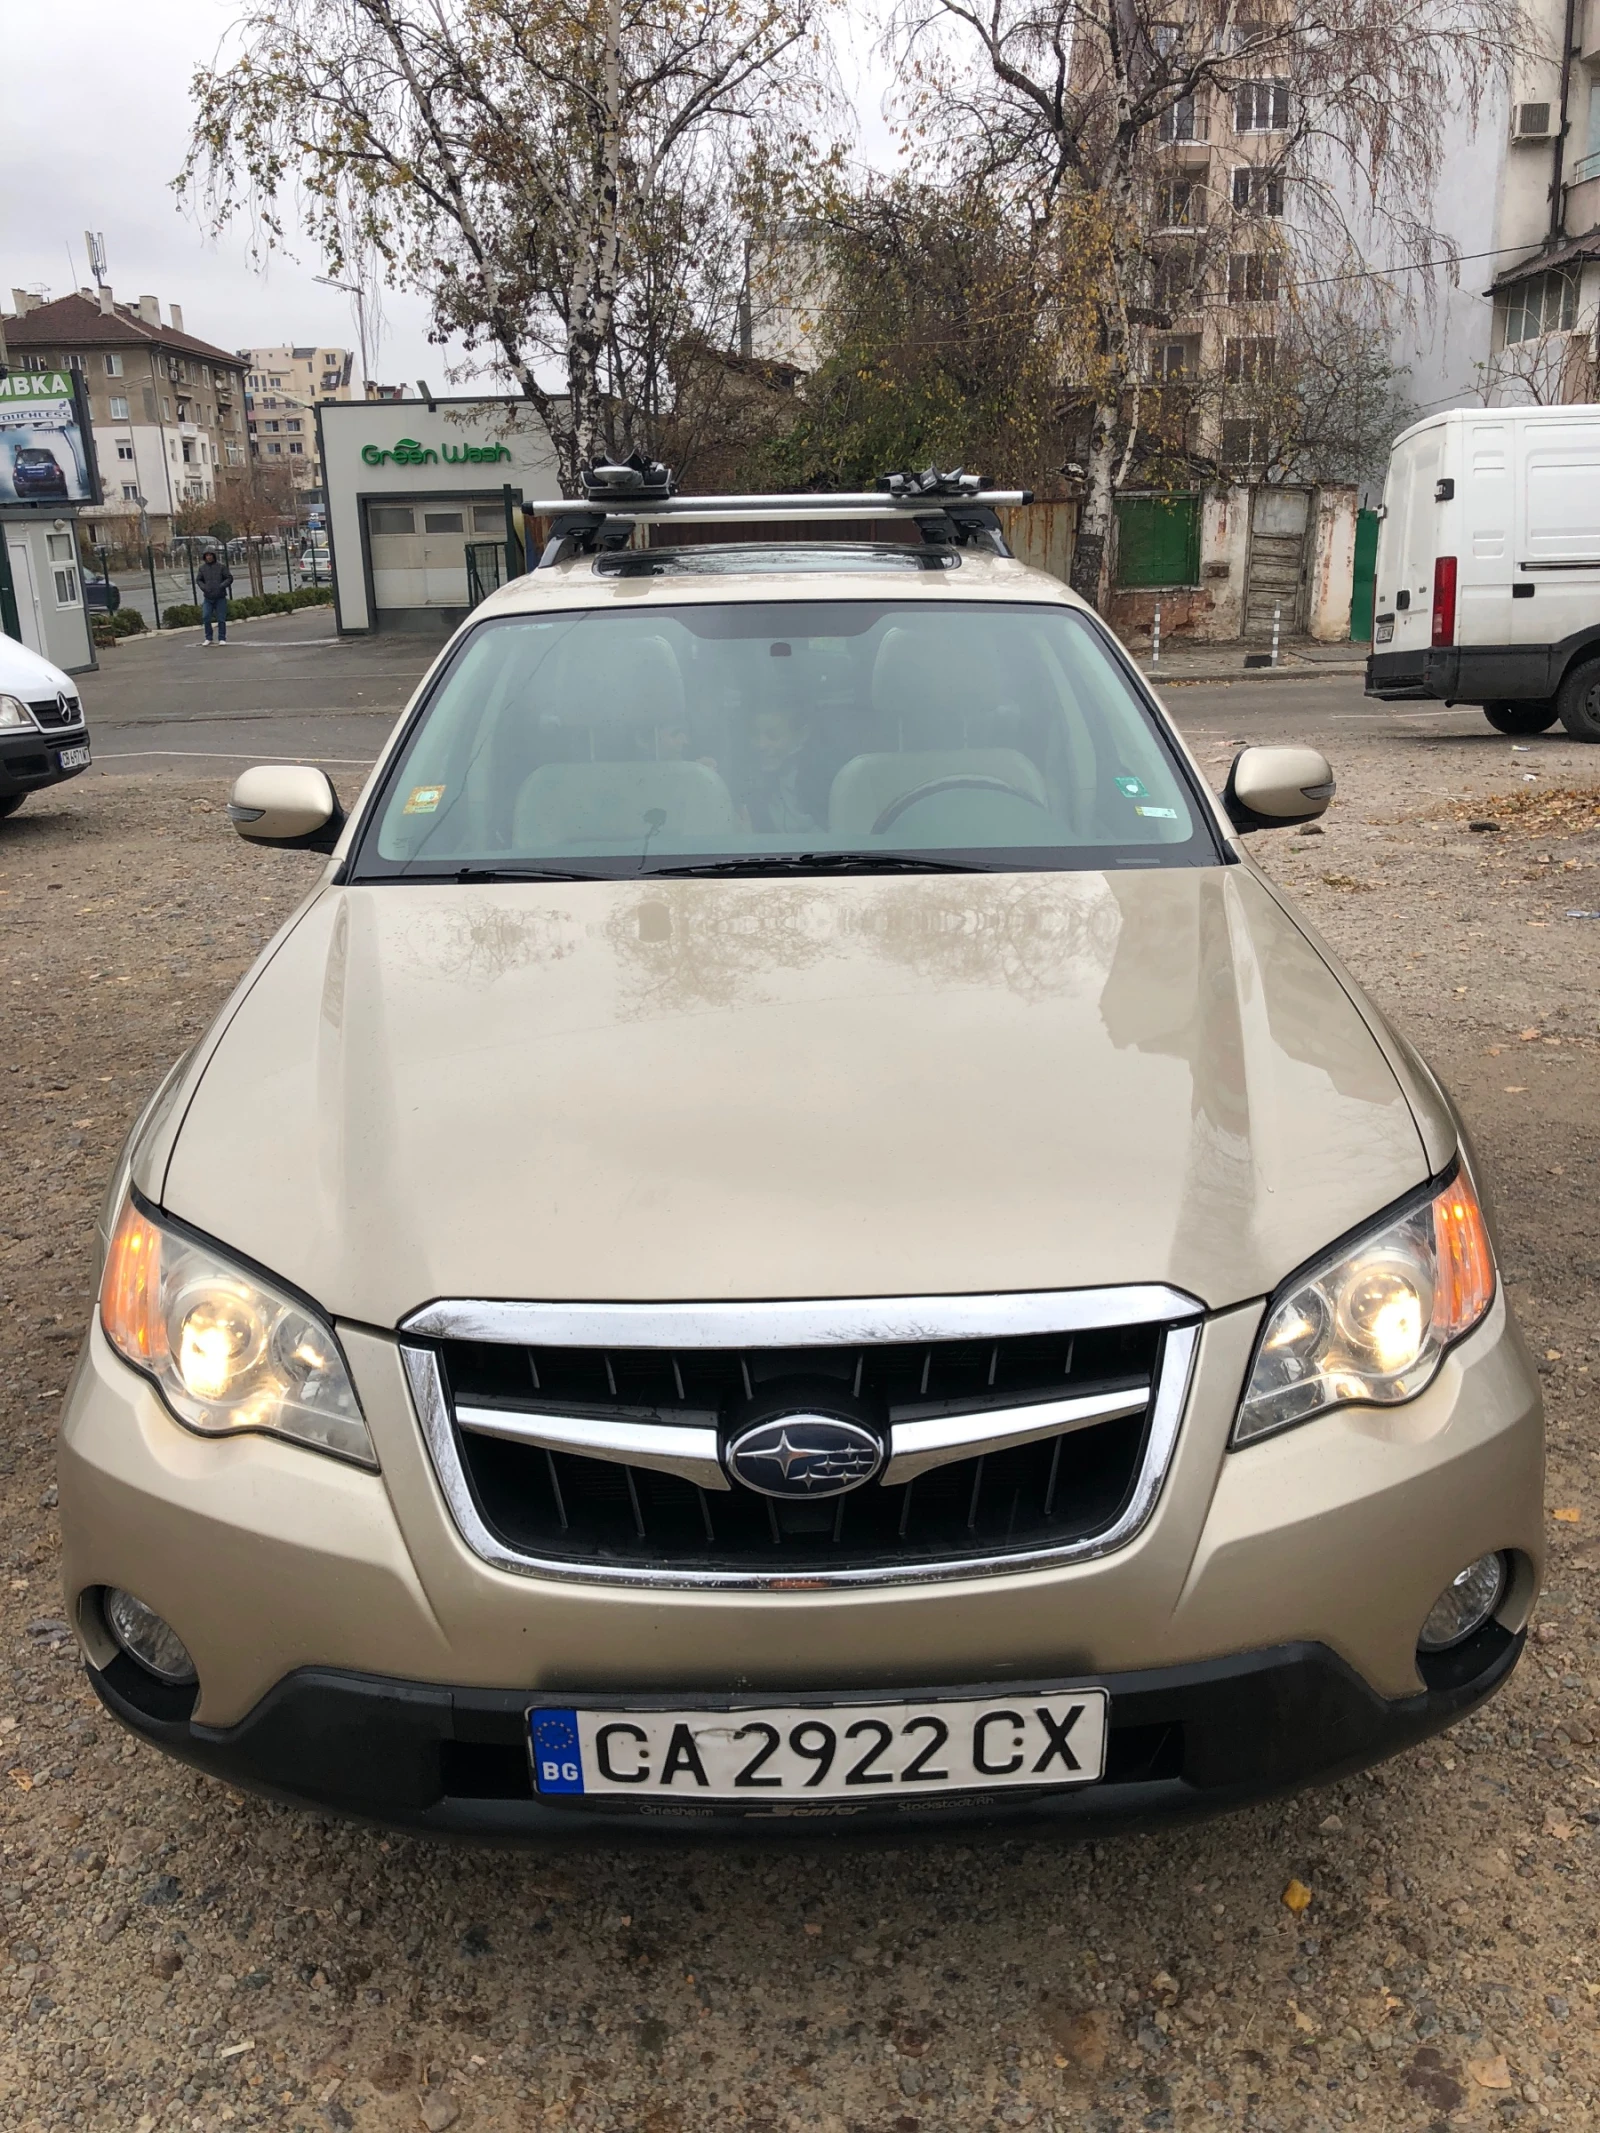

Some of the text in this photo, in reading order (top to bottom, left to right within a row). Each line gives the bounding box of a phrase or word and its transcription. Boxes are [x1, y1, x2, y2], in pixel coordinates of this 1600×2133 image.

[361, 442, 512, 466] Green Wash
[595, 1705, 1086, 1787] CA 2922 CX
[542, 1762, 578, 1781] BG
[640, 1804, 714, 1817] Griesheim
